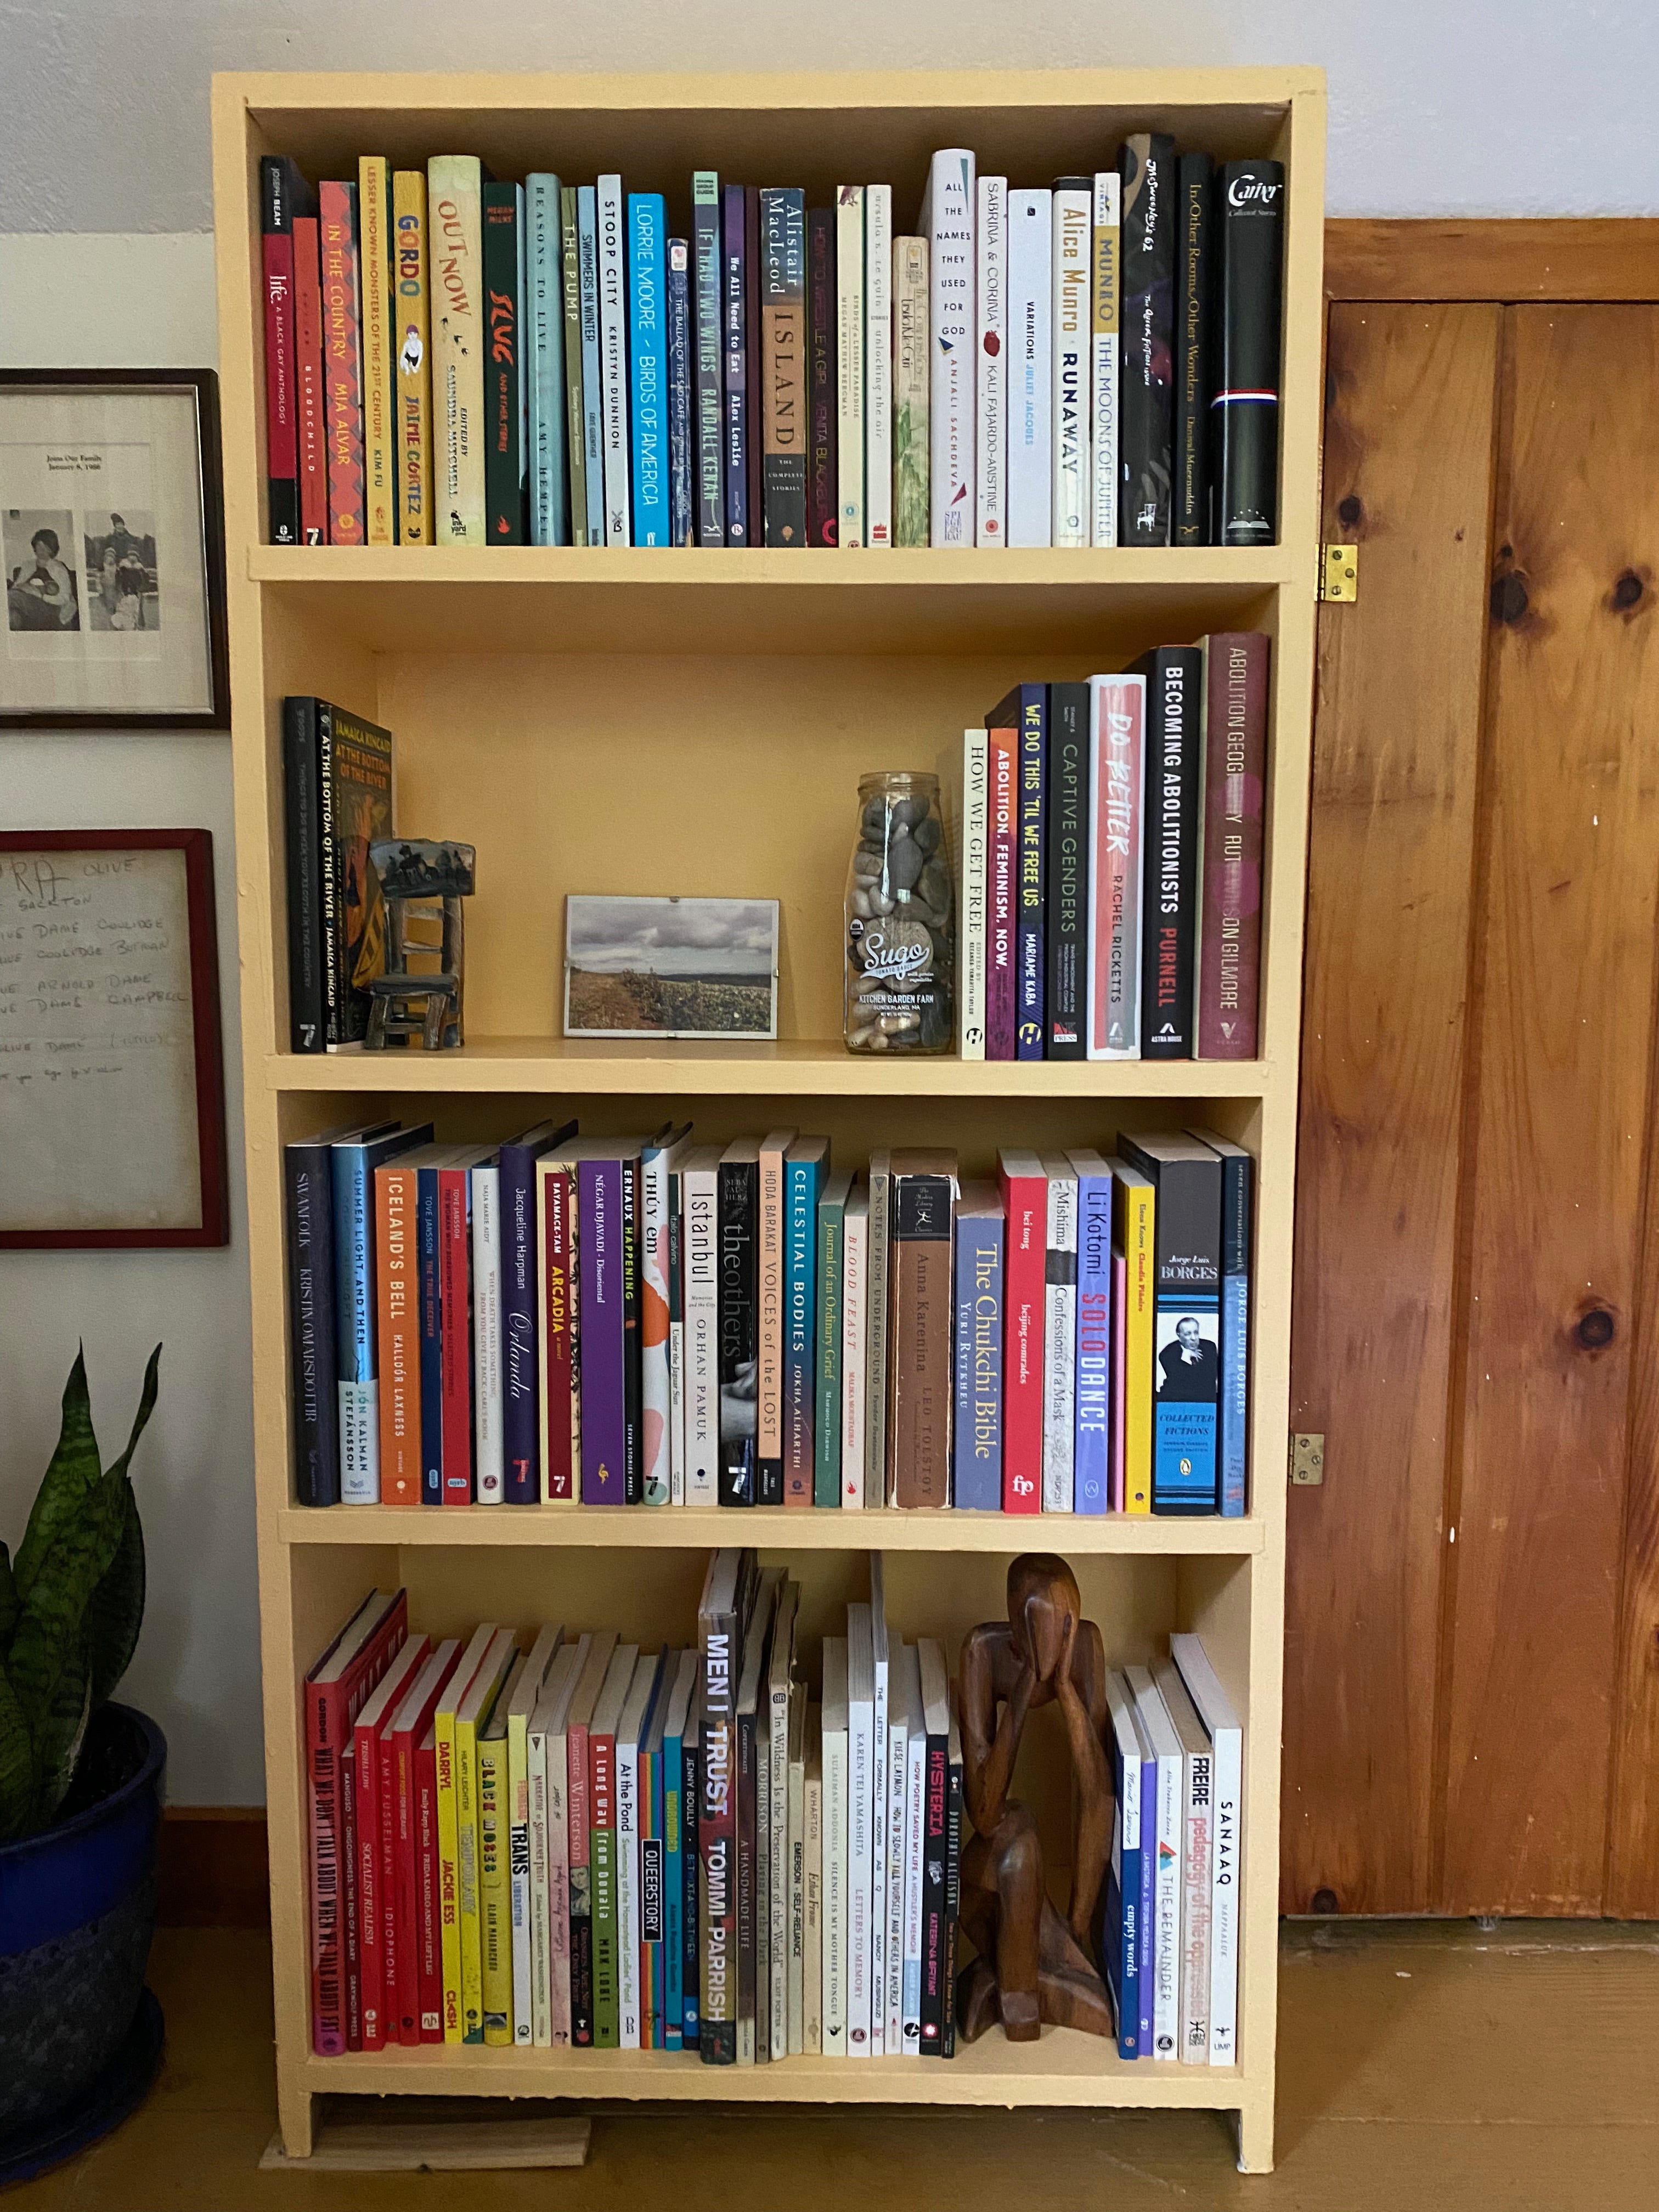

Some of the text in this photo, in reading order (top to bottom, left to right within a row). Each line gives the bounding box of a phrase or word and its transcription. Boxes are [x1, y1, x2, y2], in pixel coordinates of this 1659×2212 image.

[271, 168, 282, 225] JOSEPH BEAM
[945, 183, 962, 191] ALL
[398, 215, 420, 296] GORDO
[438, 200, 472, 317] OUT NOW
[565, 224, 577, 320] THE PUMP
[605, 201, 617, 306] STOOP CITY
[637, 205, 655, 330] LORRIE MOORE
[769, 197, 785, 294] MacLeod
[787, 205, 803, 287] Alistair
[1062, 208, 1086, 331] Alice Munro
[1099, 239, 1113, 320] MUNRO
[270, 275, 287, 303] life.
[328, 225, 346, 360] IN THE COUNTRY
[730, 257, 740, 373] We All Need to Eat
[944, 303, 963, 311] FOR
[1026, 301, 1035, 360] VARIATIONS
[609, 326, 620, 449] KRISTYN DUNNION
[774, 313, 794, 445] ISLAND
[1062, 353, 1078, 474] RUNAWAY
[335, 383, 350, 465] MIA ALVAR
[405, 396, 421, 515] JAIME CORTEZ
[639, 356, 658, 506] BIRDS OF AMERICA
[732, 395, 741, 467] Alex Leslie
[1025, 704, 1041, 725] WE
[1025, 731, 1040, 752] DO
[997, 749, 1010, 839] ABOLITION.
[1024, 758, 1040, 790] THIS
[1105, 712, 1133, 856] DO BETTER
[321, 736, 334, 918] AT THE BOTTOM OF THE RIVER
[969, 746, 984, 933] HOW WE GET FREE
[1024, 825, 1040, 845] WE
[1024, 851, 1039, 883] FREE
[1061, 744, 1078, 933] CAPTIVE GENDERS
[1158, 667, 1183, 1007] BECOMING ABOLITIONISTS PURNELL
[996, 844, 1009, 923] FEMINISM.
[1024, 889, 1039, 907] US
[326, 927, 335, 967] JAMAICA
[865, 933, 929, 981] Sugo
[995, 929, 1008, 970] NOW.
[1025, 933, 1037, 1006] MARIAME KABA
[1110, 876, 1123, 1003] RACHEL RICKETTS
[859, 994, 886, 1003] KITCHEN
[888, 994, 915, 1003] GARDEN
[388, 1177, 405, 1319] ICELAND'S BELL
[514, 1187, 527, 1289] Jacqueline Harpman
[624, 1170, 634, 1301] ERNAUX HAPPENING
[646, 1171, 661, 1254] THÚY em
[691, 1193, 714, 1283] Istanbul
[765, 1170, 777, 1253] HODA BARAKAT
[1086, 1192, 1107, 1274] Li Kotomi
[552, 1266, 564, 1333] ARCADIA
[793, 1170, 806, 1352] CELESTIAL BODIES
[822, 1221, 837, 1380] Journal of an Ordinary Grief
[848, 1235, 857, 1350] BLOOD FEAST
[1161, 1266, 1218, 1280] BORGES
[509, 1310, 533, 1399] Orlanda
[697, 1318, 707, 1441] ORHAN PAMUK
[764, 1262, 777, 1437] VOICES of the LOST
[975, 1243, 998, 1459] The Chukchi Bible
[1019, 1304, 1031, 1384] beijing comrades
[1080, 1293, 1107, 1432] SOLO DANCE
[395, 1389, 404, 1436] LAXNESS
[793, 1363, 802, 1469] JOKHA ALHARTHI
[707, 1634, 729, 1695] MEN
[439, 1741, 450, 1790] DARRYL
[620, 1763, 634, 1832] At the Pond
[706, 1726, 728, 1815] TRUST
[856, 1733, 865, 1857] KAREN TEI YAMASHITA
[929, 1751, 945, 1837] HYSTERIA
[1192, 1758, 1210, 1805] FREIRE
[512, 1823, 528, 1875] TRANS
[794, 1842, 802, 1883] EMERSON
[1216, 1801, 1233, 1885] SANAAQ
[443, 1859, 455, 1925] JACKIE ESS
[646, 1850, 658, 1932] QUEERSTORY
[707, 1841, 726, 2022] TOMMI PARRISH
[1124, 1905, 1138, 1977] empty words
[1160, 1876, 1174, 2001] THE REMAINDER
